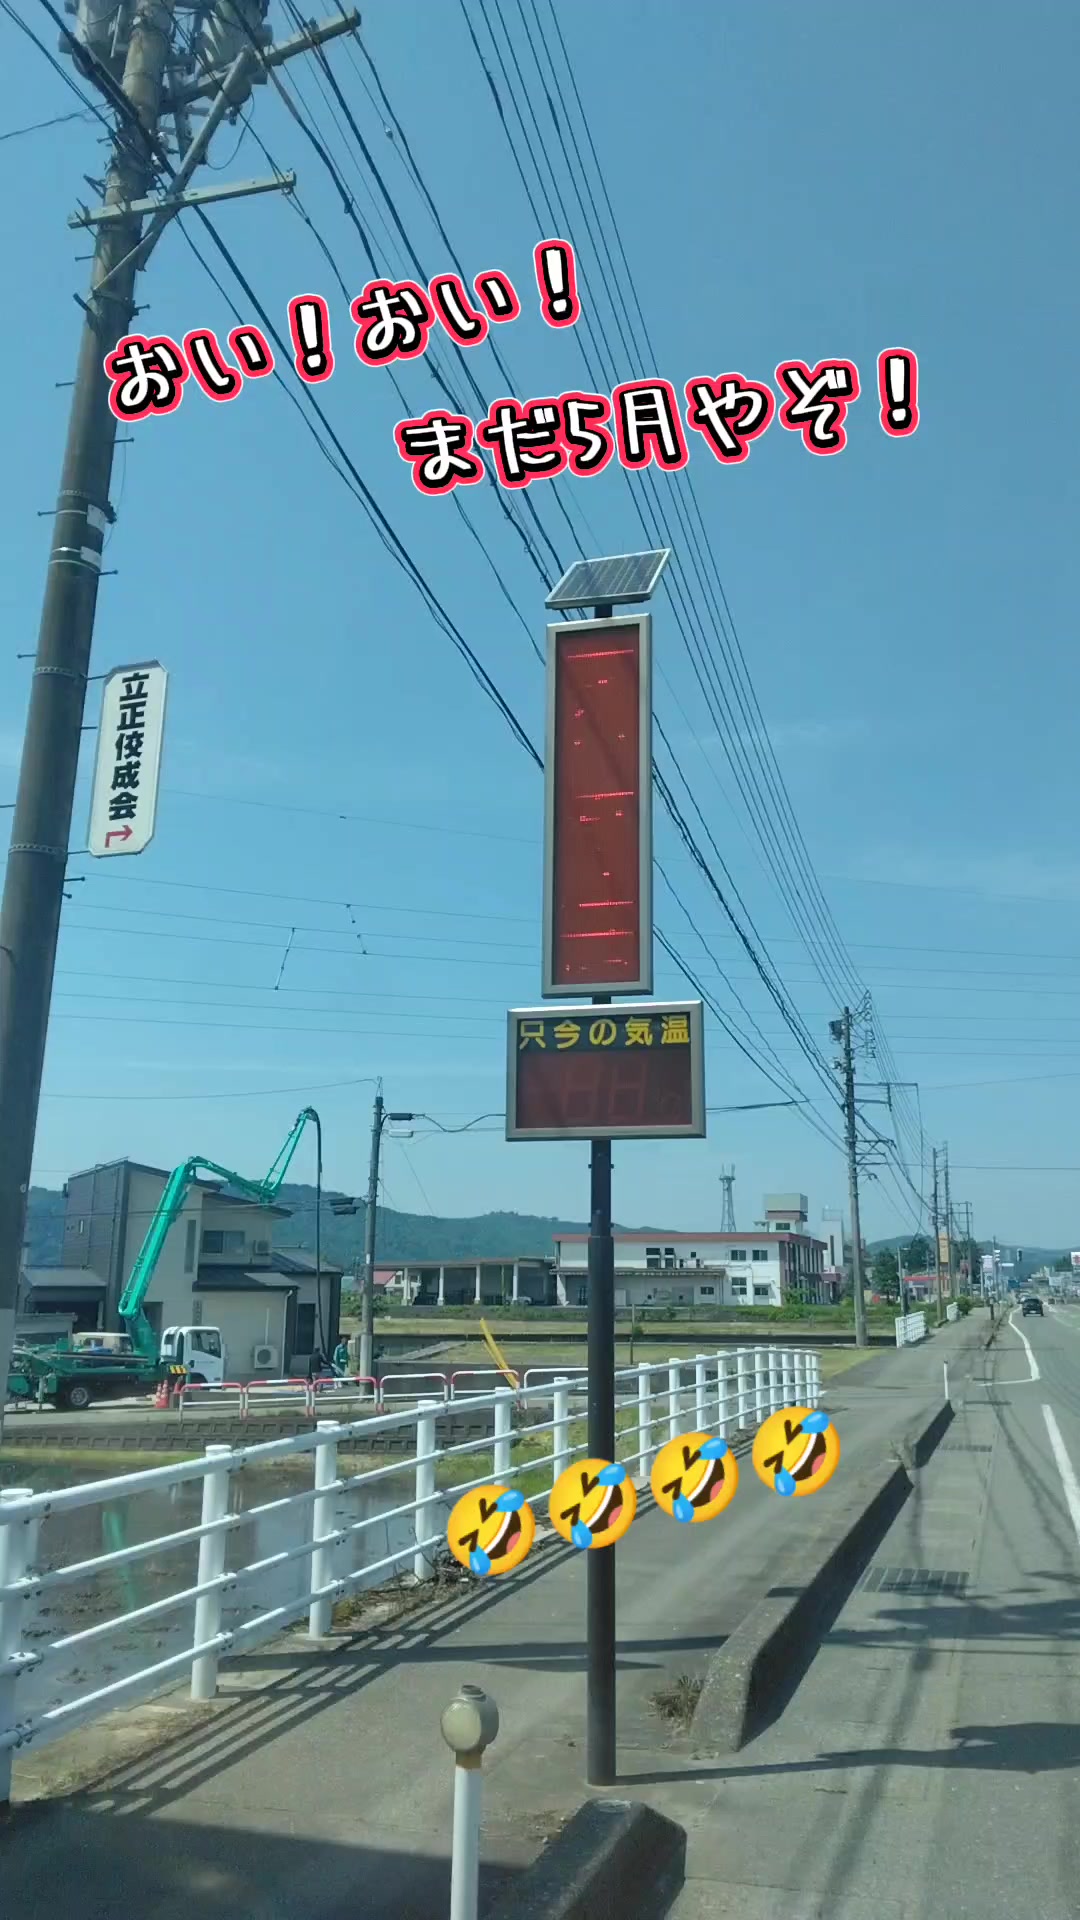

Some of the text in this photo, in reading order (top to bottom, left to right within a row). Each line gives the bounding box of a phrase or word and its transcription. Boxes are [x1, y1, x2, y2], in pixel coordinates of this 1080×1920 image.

[108, 671, 150, 821] 立正佼成会
[519, 1014, 690, 1050] 只今の気温
